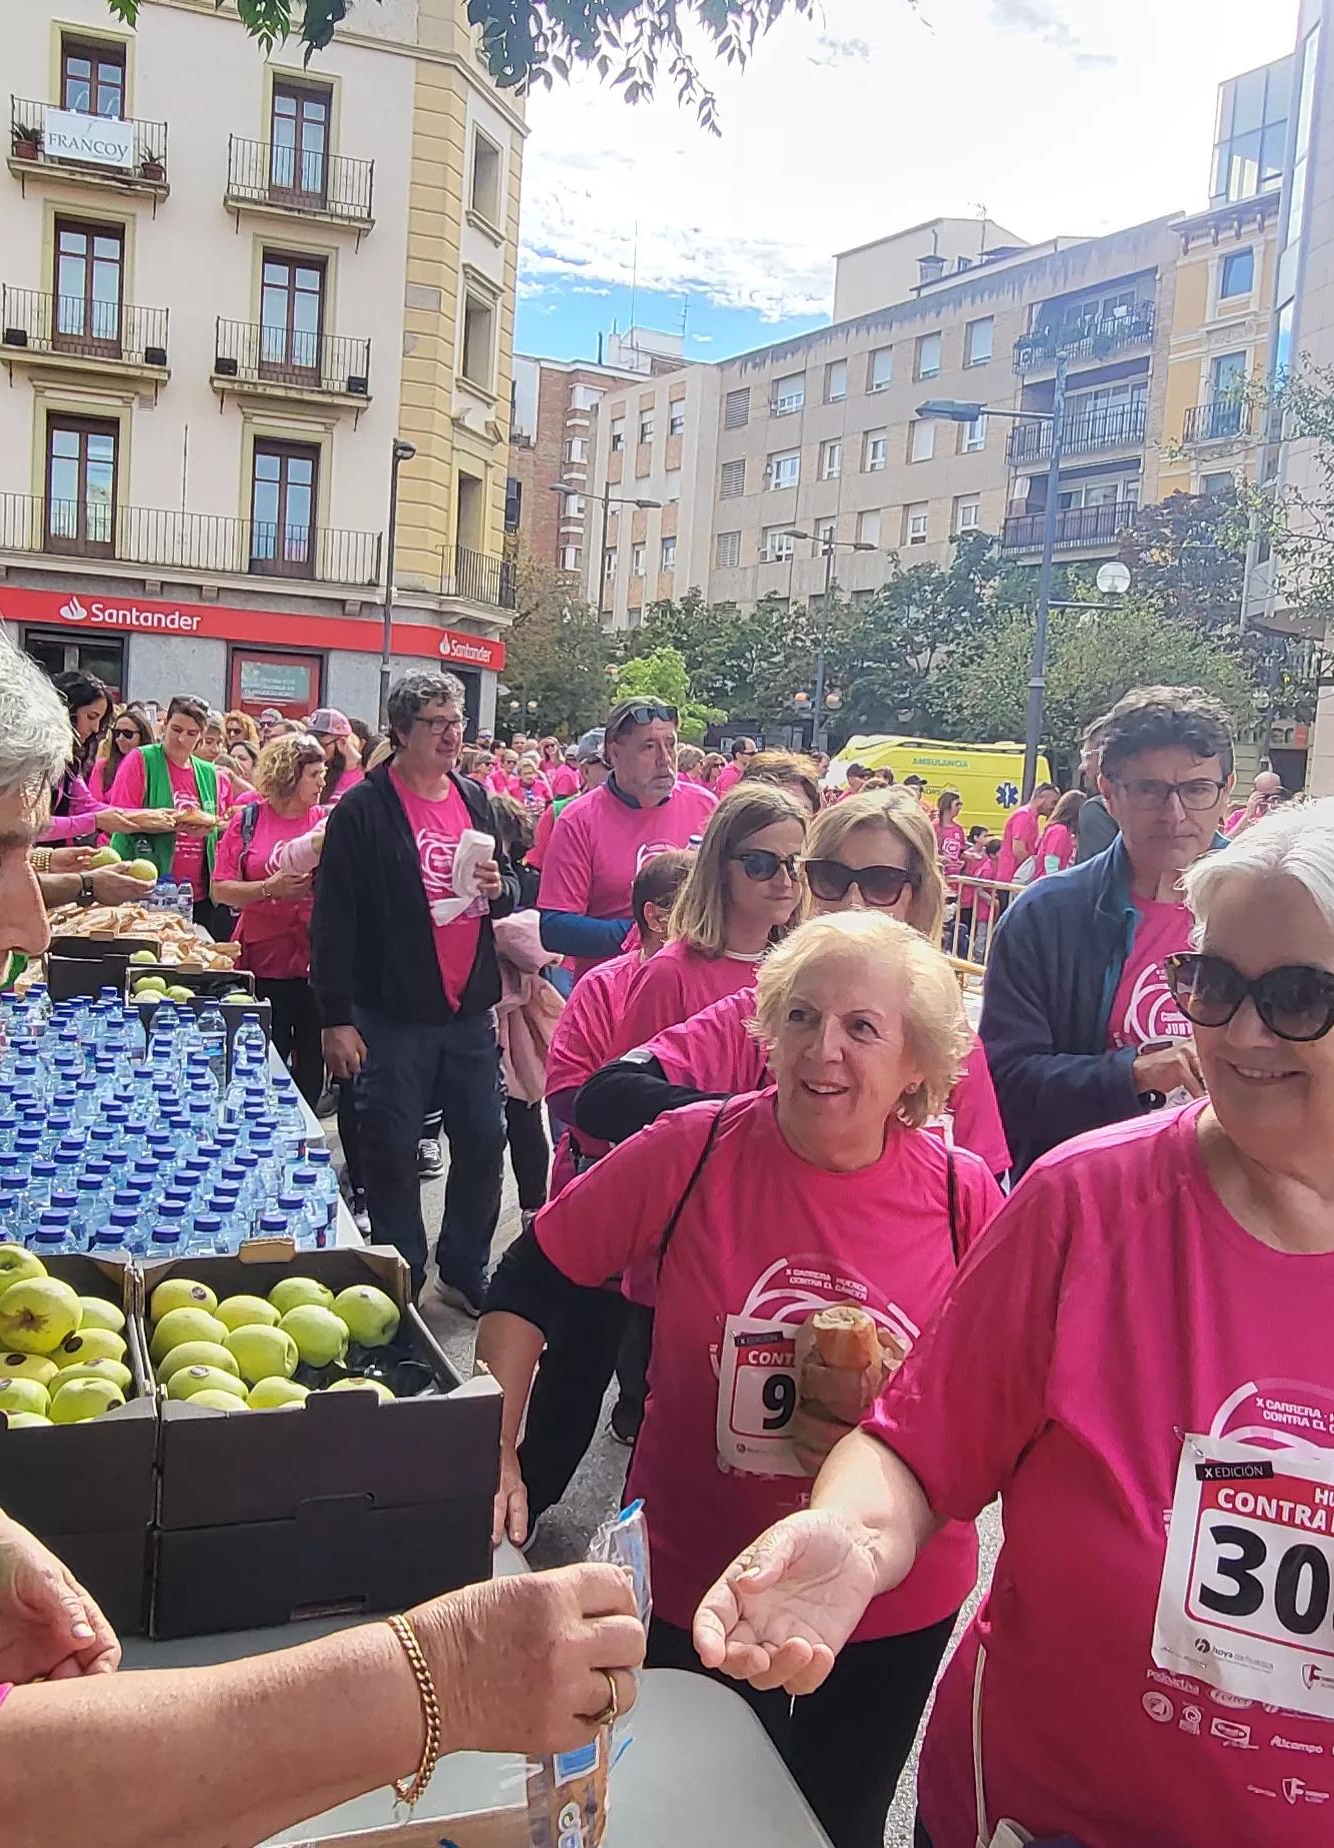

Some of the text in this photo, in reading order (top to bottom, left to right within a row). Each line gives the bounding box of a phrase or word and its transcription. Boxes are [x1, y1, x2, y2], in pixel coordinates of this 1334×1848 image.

[47, 131, 130, 162] FRANCOY
[90, 603, 202, 631] Santander
[450, 639, 492, 663] Santander
[912, 757, 969, 768] AMBULANCIA
[762, 1373, 797, 1431] 9
[1255, 1397, 1265, 1408] X
[1265, 1399, 1322, 1419] CARRERA
[1262, 1409, 1310, 1428] CONTRA
[1312, 1419, 1327, 1432] EL
[1204, 1464, 1265, 1479] X EDICIÓN
[1217, 1487, 1327, 1532] CONTRA
[1270, 1734, 1324, 1754] Alcampo
